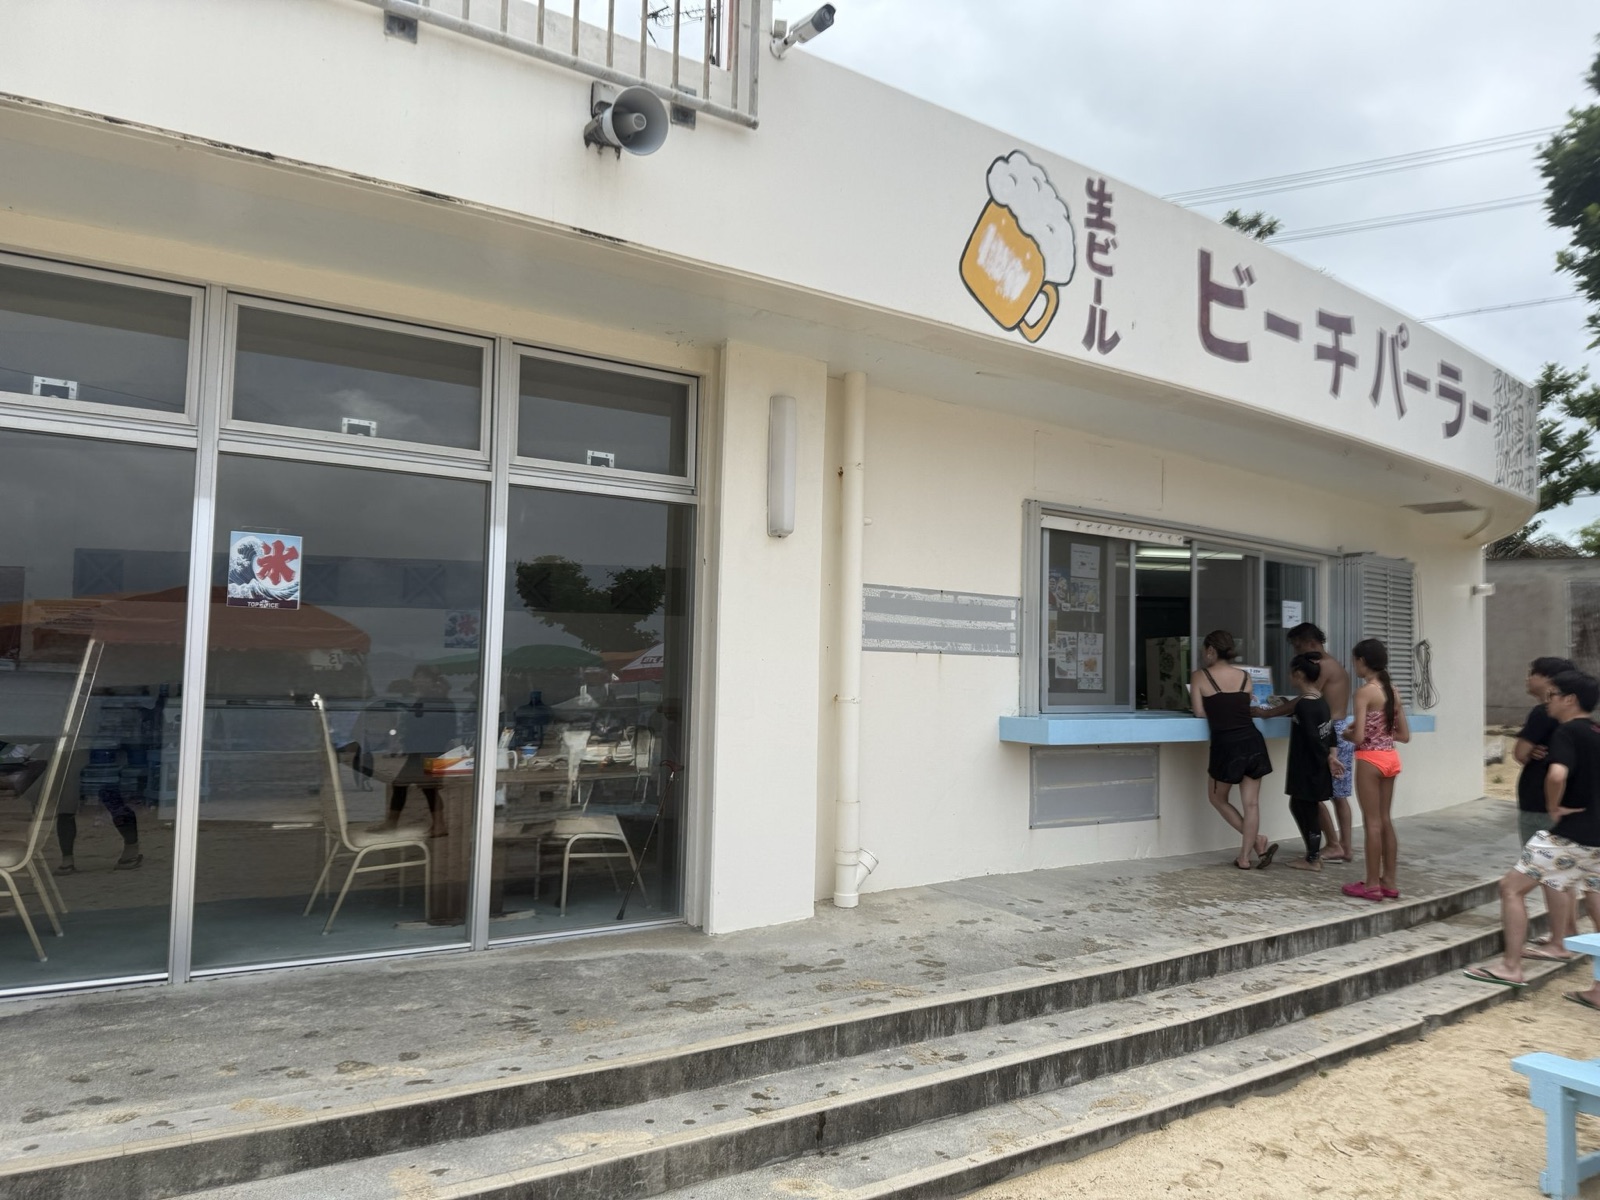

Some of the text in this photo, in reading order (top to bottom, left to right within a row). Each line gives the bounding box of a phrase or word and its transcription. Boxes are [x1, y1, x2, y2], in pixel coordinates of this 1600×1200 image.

[1081, 176, 1121, 355] 生ビール
[1197, 247, 1491, 439] ビーチパーラー
[256, 540, 299, 586] 氷
